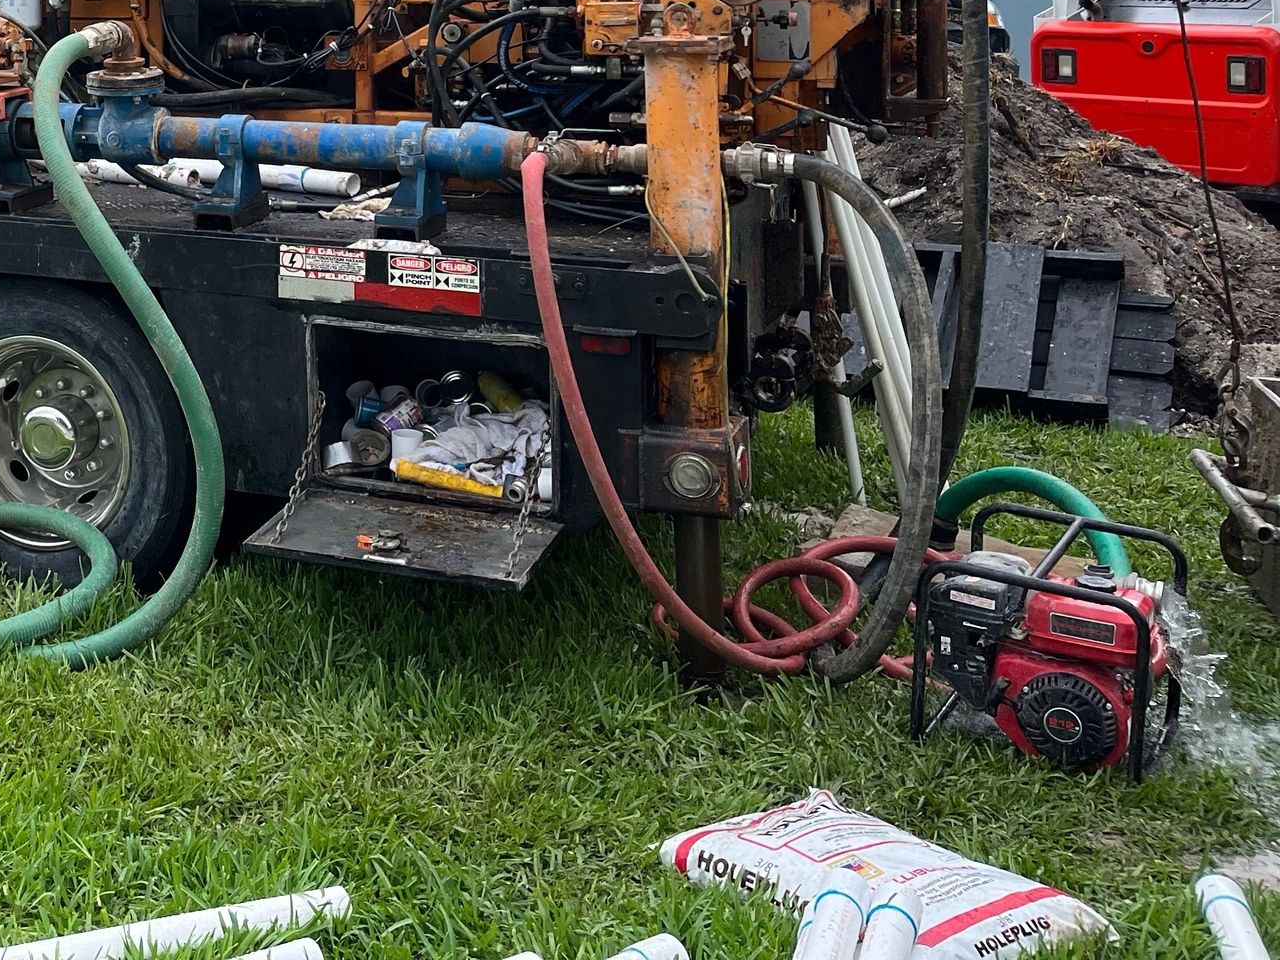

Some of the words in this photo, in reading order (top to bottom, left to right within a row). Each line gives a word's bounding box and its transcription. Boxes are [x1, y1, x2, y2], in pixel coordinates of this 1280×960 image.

[396, 259, 425, 268] DANGER
[441, 262, 472, 272] PELIGRO
[317, 271, 365, 282] PELIGRO
[974, 916, 1051, 958] HOLEPLUG
